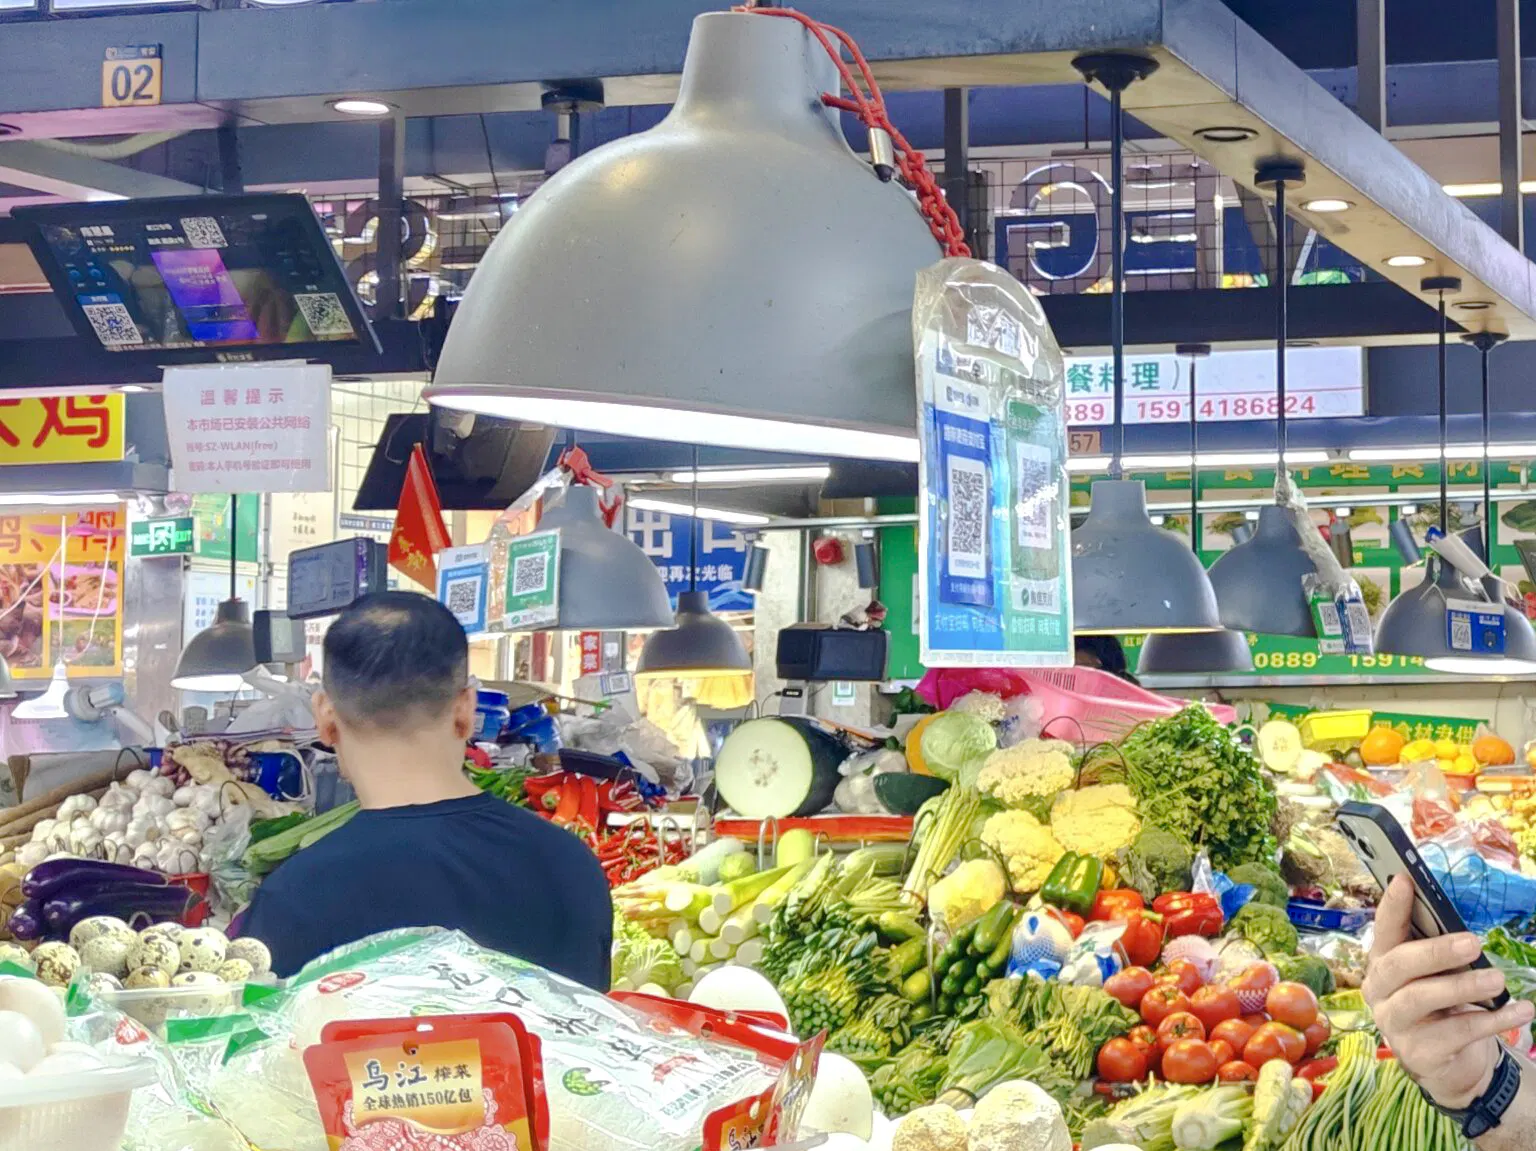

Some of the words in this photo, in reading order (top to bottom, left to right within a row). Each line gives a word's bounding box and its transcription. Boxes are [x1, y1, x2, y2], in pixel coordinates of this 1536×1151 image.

[111, 64, 154, 101] 02
[0, 395, 110, 449] 鸡
[1254, 652, 1316, 668] 0889
[362, 1059, 428, 1092] 乌江
[433, 1063, 472, 1083] 榨菜
[362, 1088, 473, 1111] 全球热销150亿包
